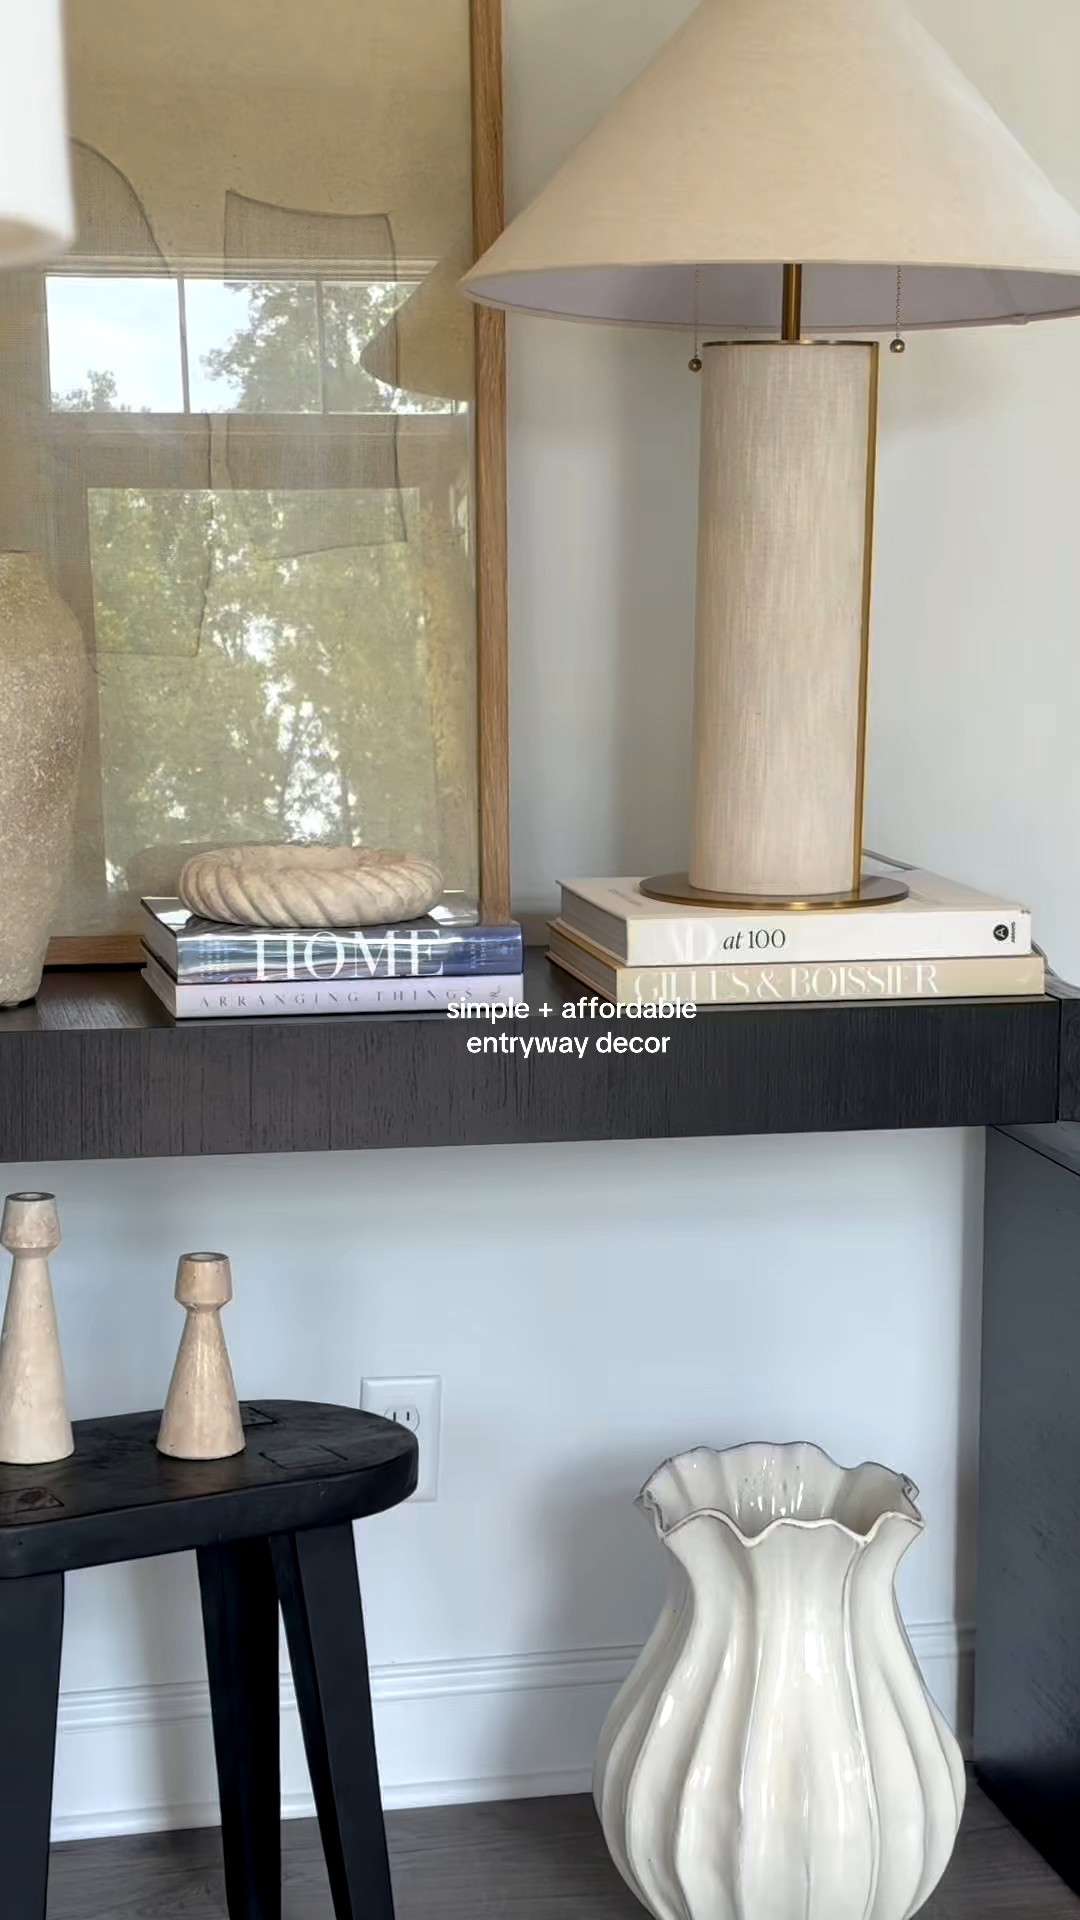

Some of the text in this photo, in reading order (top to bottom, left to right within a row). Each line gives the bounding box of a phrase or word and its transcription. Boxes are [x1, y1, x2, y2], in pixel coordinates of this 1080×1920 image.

[254, 929, 444, 980] HOME
[722, 930, 744, 951] at
[747, 928, 787, 950] 100
[200, 986, 473, 1008] ARRANGING THINGS
[633, 963, 940, 1002] GILLES & BOISSIER
